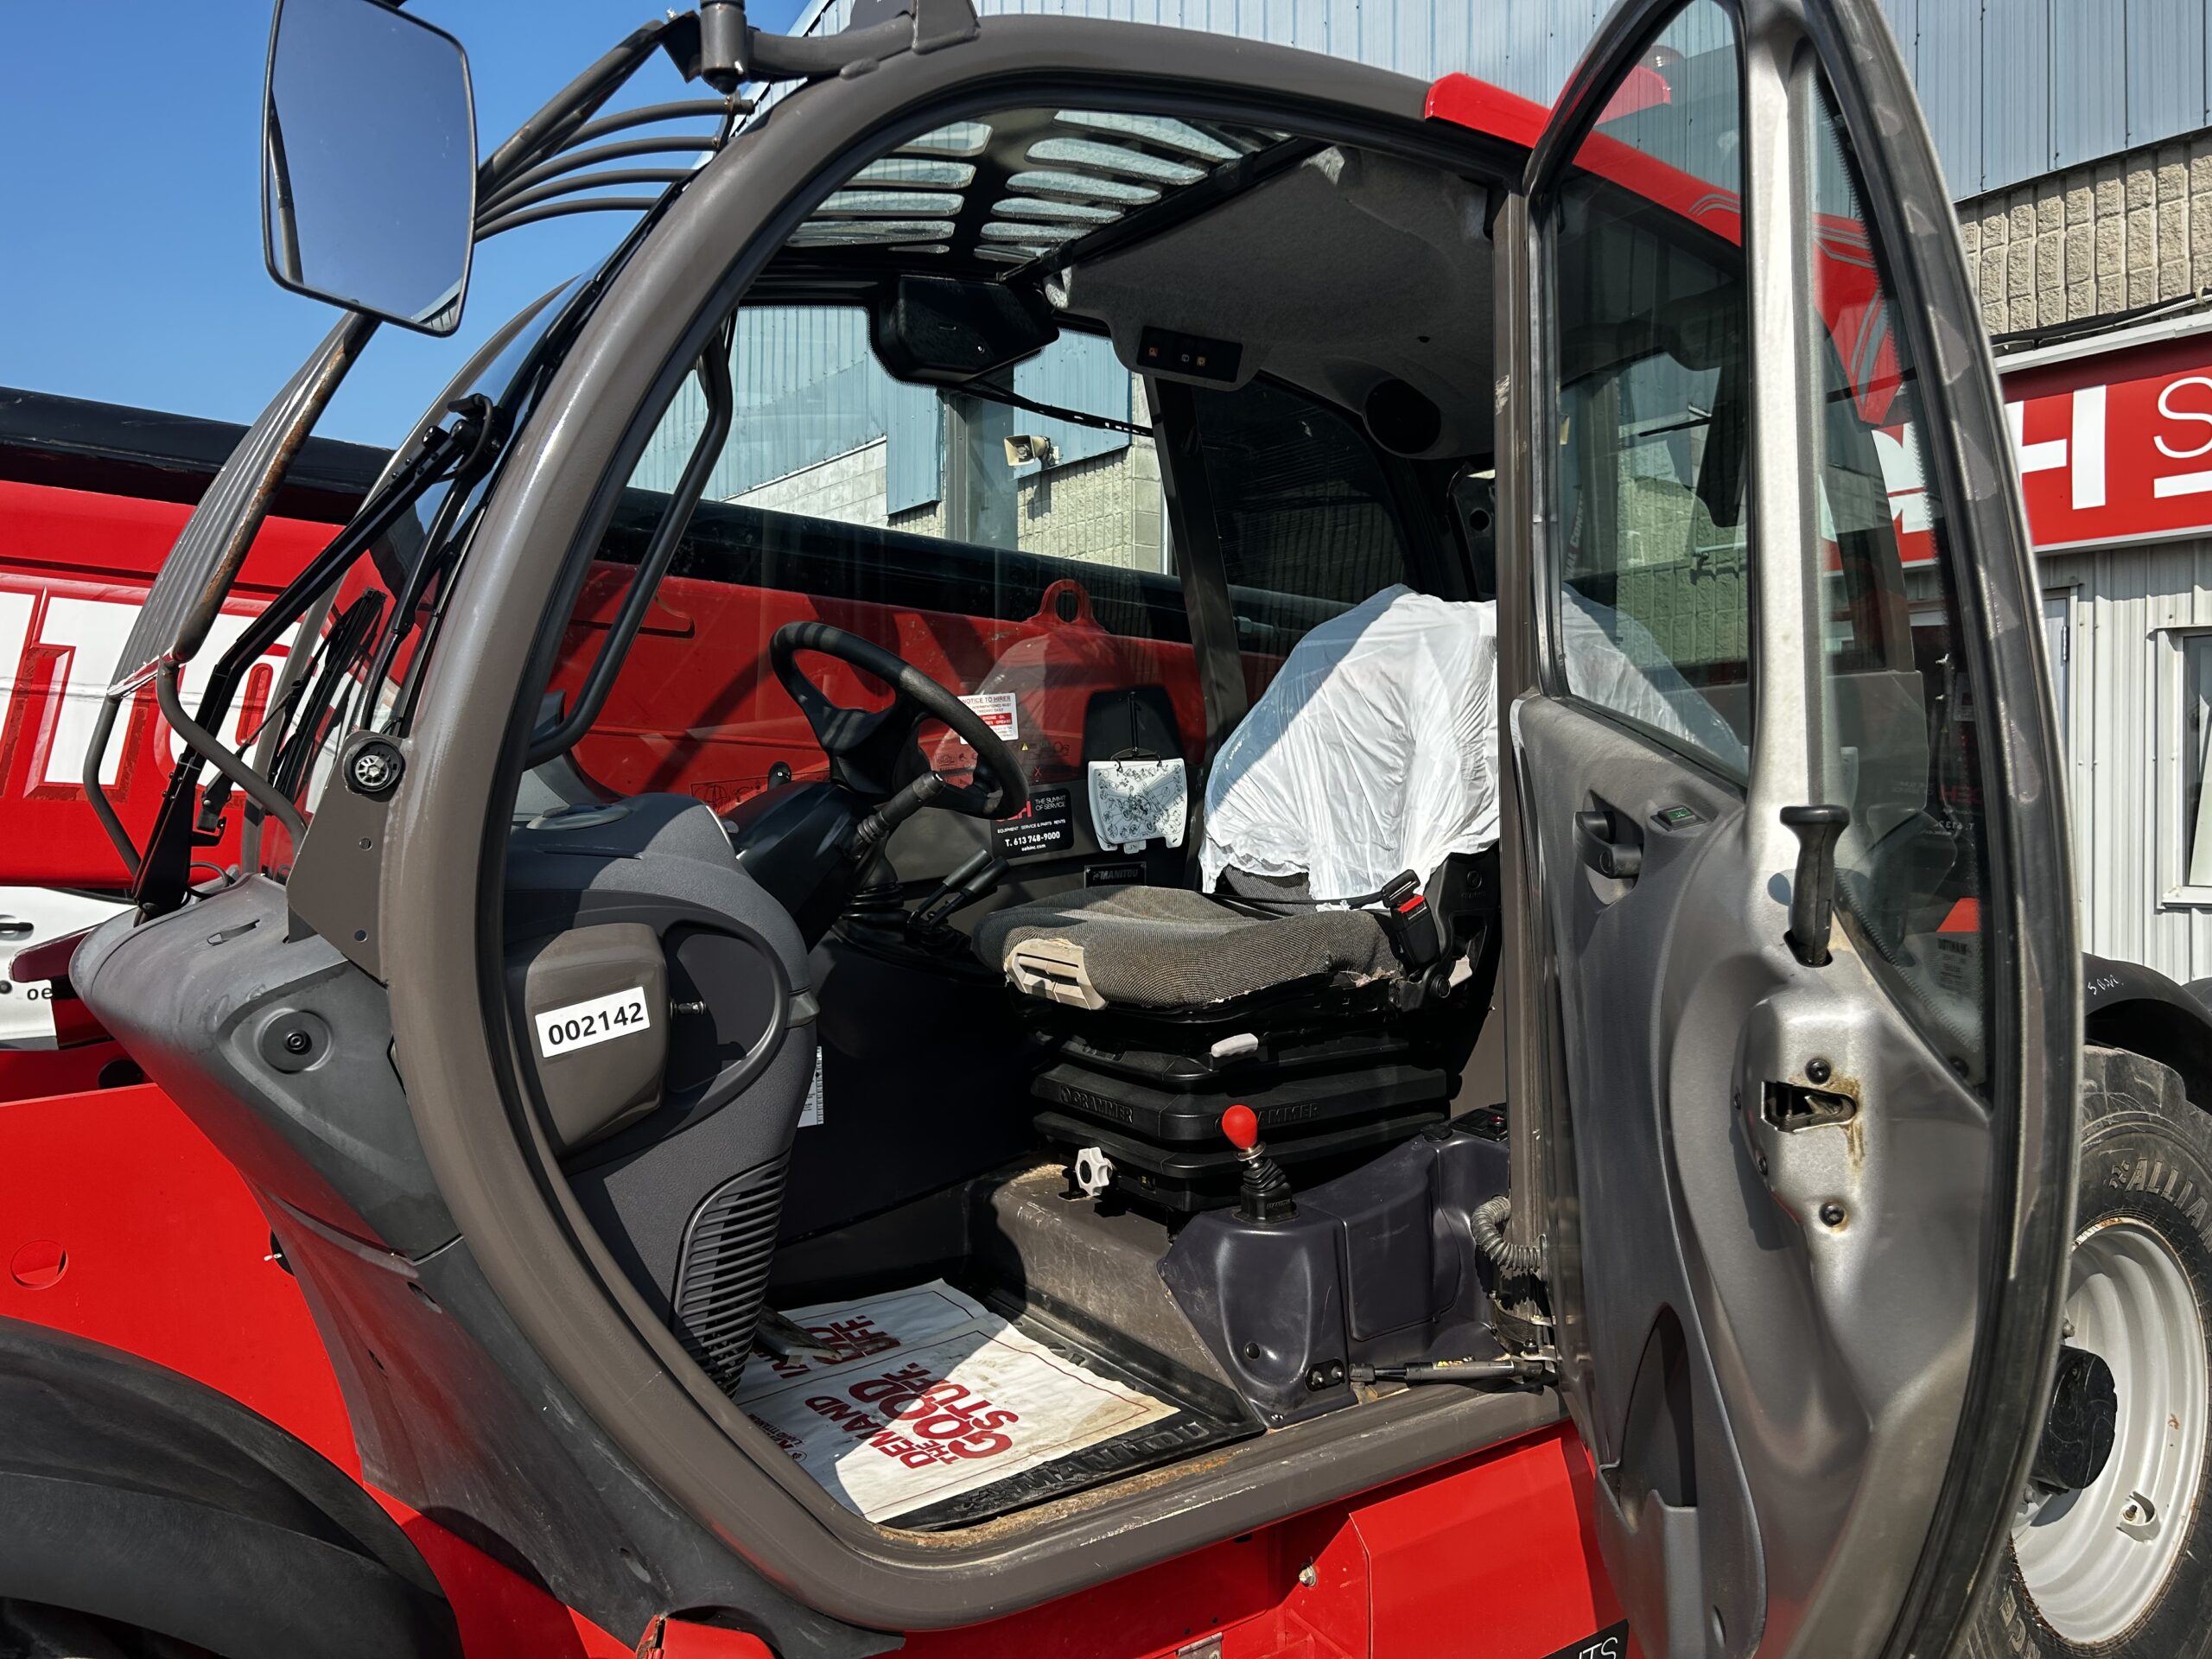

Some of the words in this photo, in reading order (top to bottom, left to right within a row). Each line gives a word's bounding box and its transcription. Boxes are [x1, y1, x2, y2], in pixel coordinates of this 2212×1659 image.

[1044, 801, 1066, 810] SERVICE
[1046, 795, 1066, 804] SUMMIT
[1004, 838, 1014, 847] T.
[1014, 836, 1027, 846] 613
[1027, 830, 1061, 843] 748-9000
[548, 1001, 644, 1046] 002142
[880, 1362, 1020, 1431] STUFF.
[804, 1395, 939, 1470] DEMAND
[849, 1379, 1014, 1459] GOOD
[917, 1440, 961, 1465] THE
